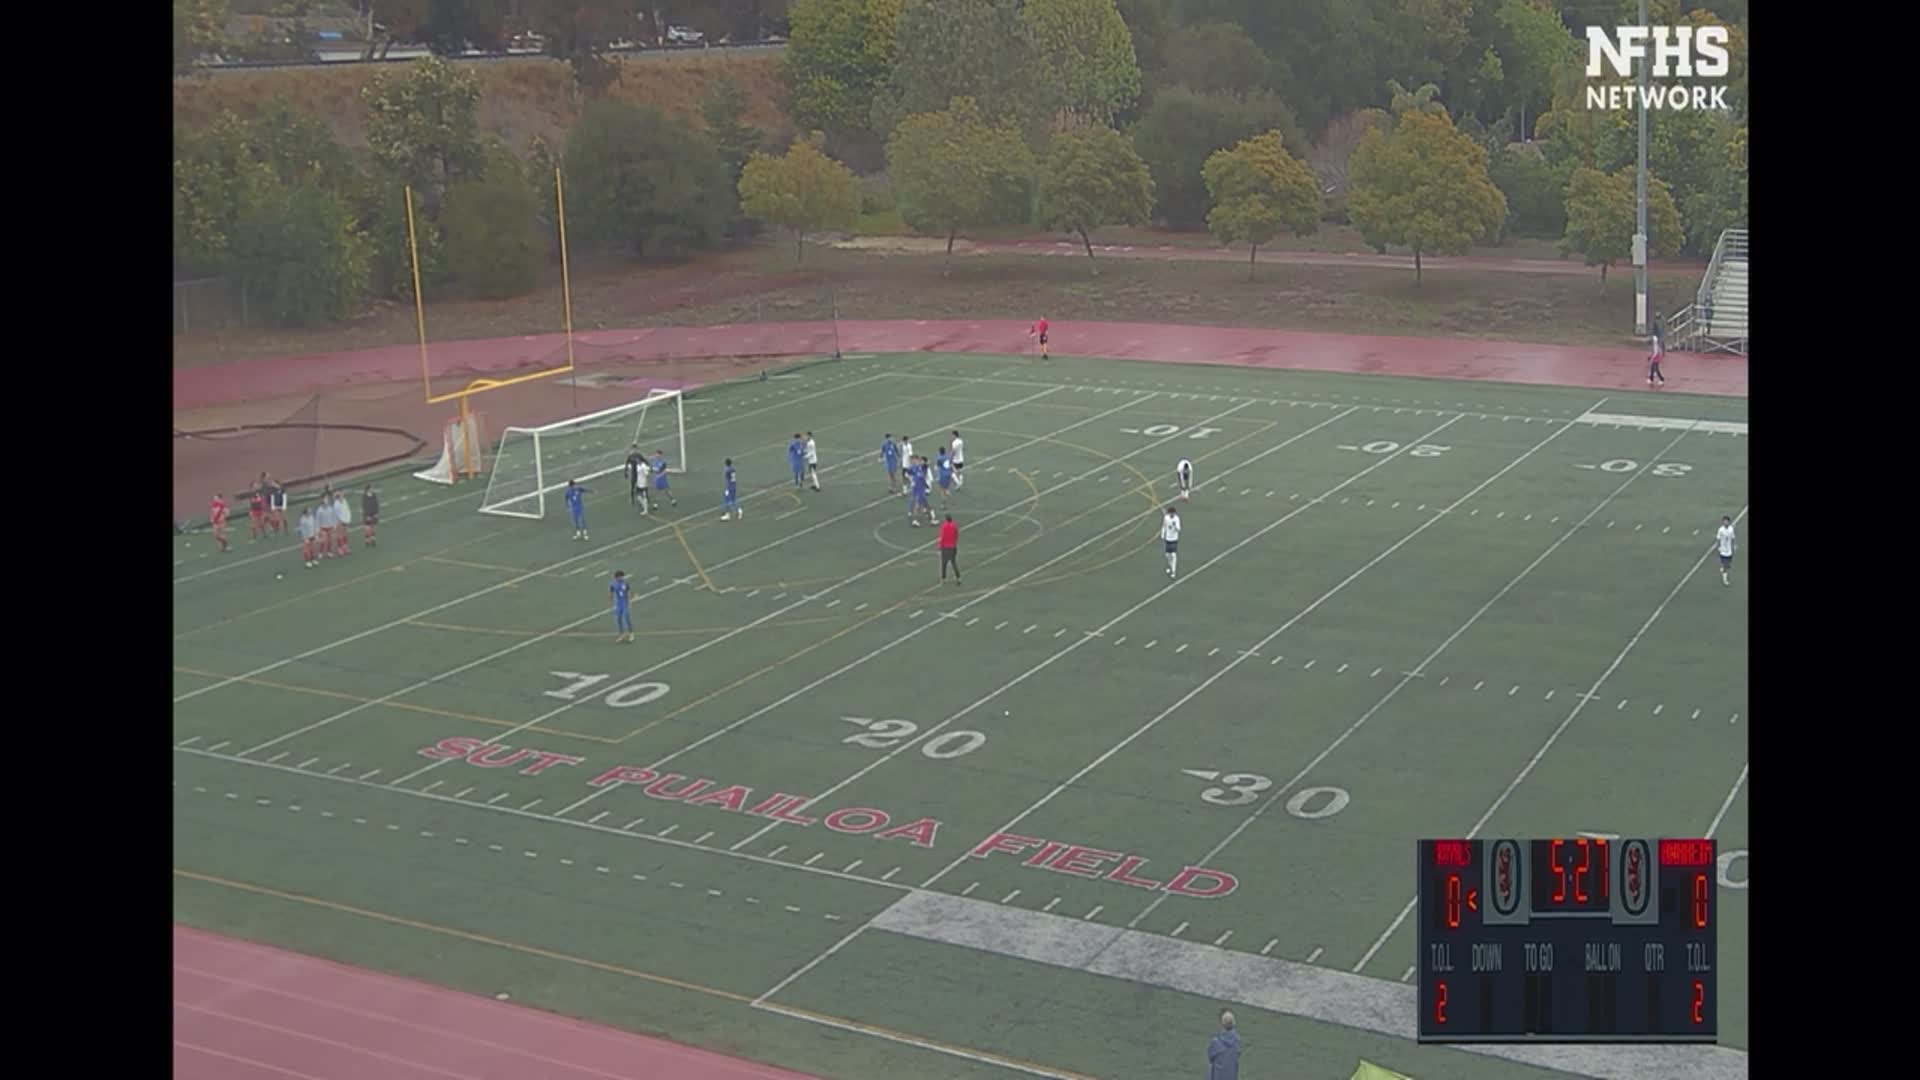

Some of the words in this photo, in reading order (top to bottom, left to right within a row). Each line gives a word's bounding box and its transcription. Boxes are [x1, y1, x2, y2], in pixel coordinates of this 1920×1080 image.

[842, 719, 987, 759] 20
[418, 737, 586, 776] SUT
[587, 766, 942, 848] PUAILOA
[968, 832, 1240, 899] FIELD
[1201, 773, 1350, 819] 30
